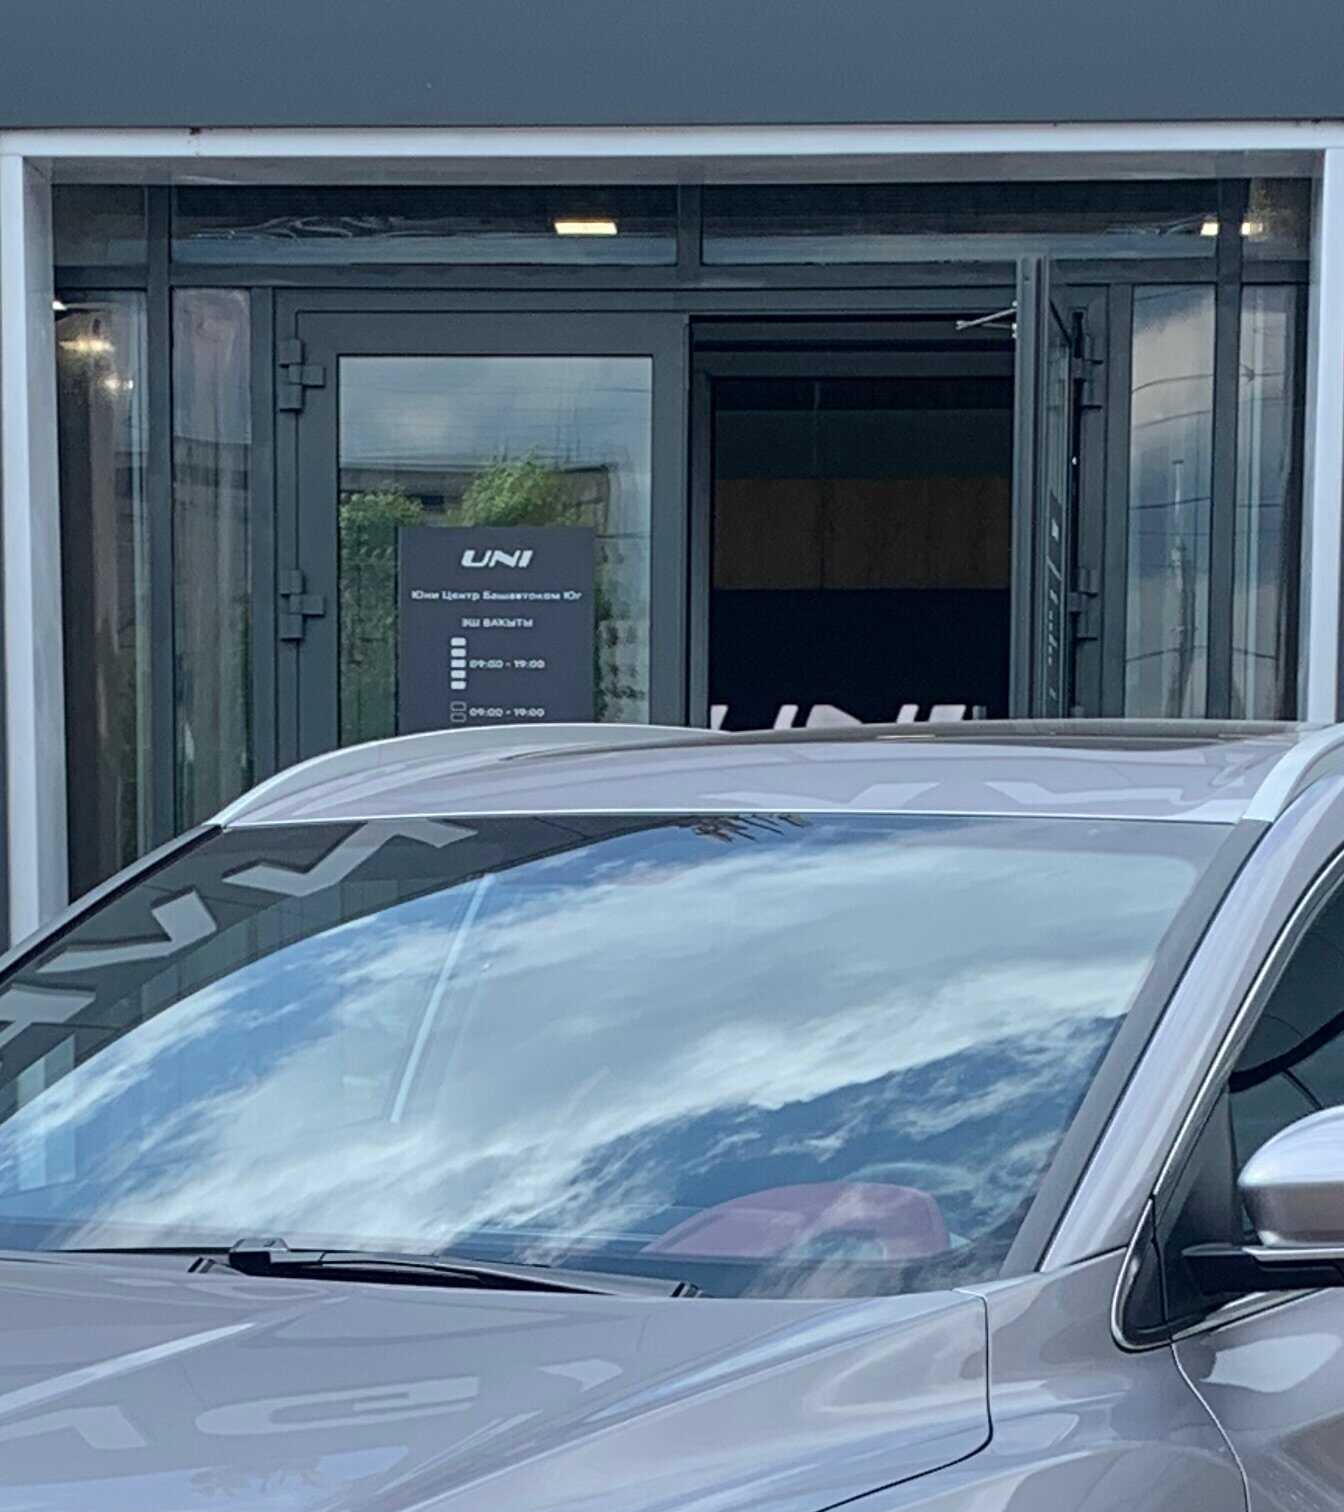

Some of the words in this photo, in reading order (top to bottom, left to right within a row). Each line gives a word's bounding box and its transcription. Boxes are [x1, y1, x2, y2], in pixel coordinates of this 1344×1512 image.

[460, 549, 534, 568] UNI
[411, 590, 440, 601] Юни
[442, 590, 481, 602] Центр
[563, 590, 583, 601] Юг
[468, 659, 504, 670] 09:00
[513, 659, 546, 670] 19:00
[468, 707, 504, 718] 09:00
[513, 707, 546, 718] 19:00
